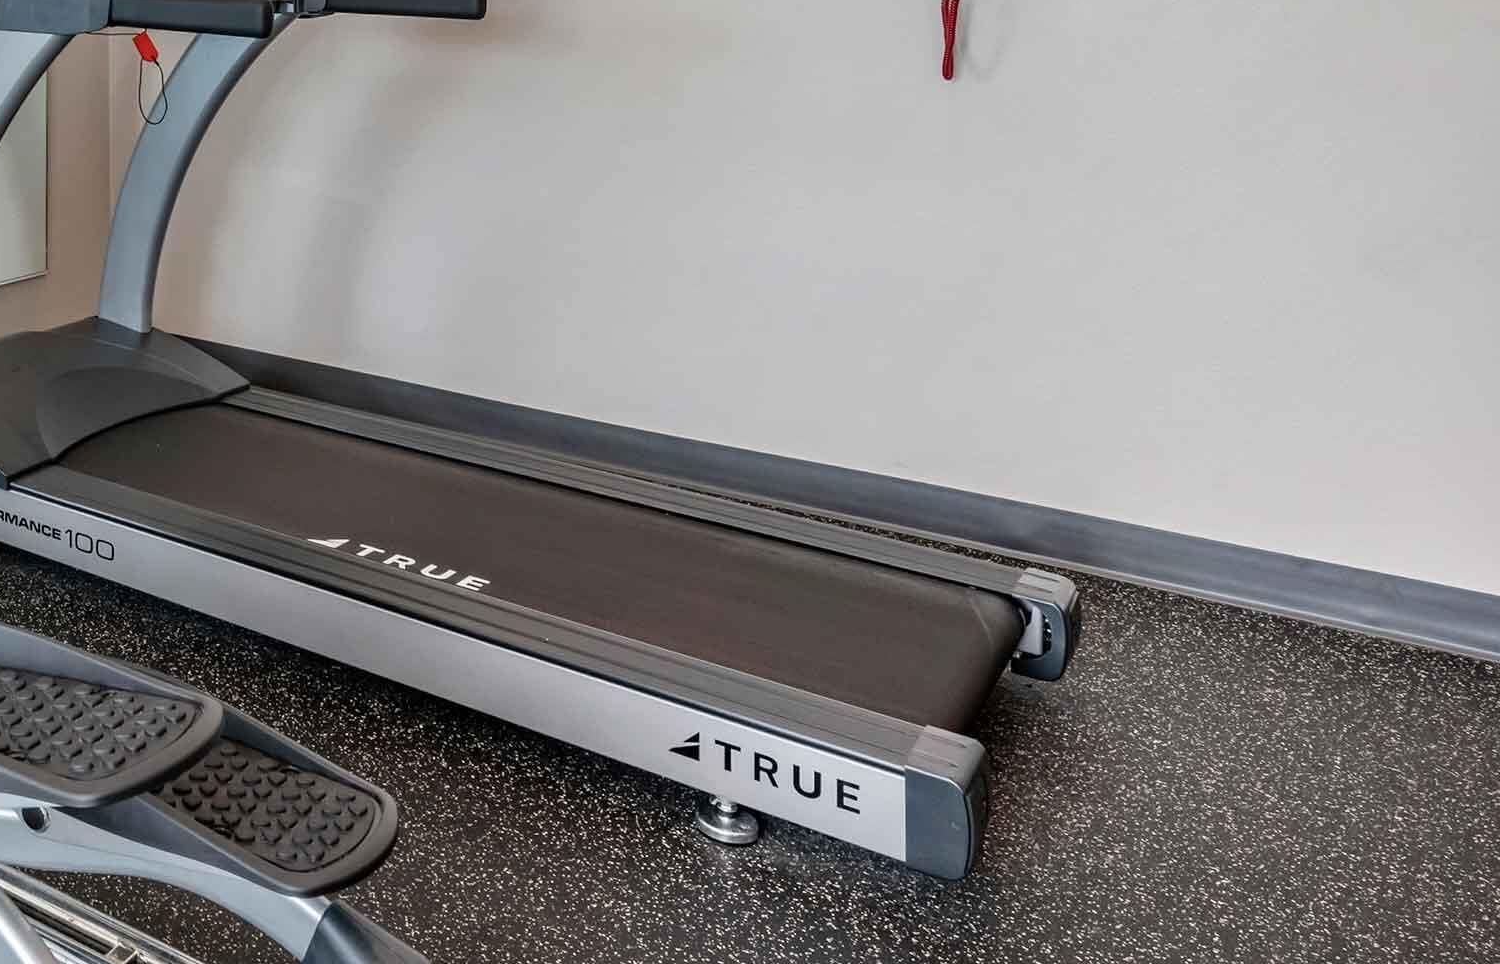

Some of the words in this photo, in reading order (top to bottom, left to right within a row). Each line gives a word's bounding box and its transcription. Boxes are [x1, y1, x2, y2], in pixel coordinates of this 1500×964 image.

[64, 528, 115, 561] 100
[356, 544, 491, 592] TRUE
[714, 739, 861, 815] TRUE
